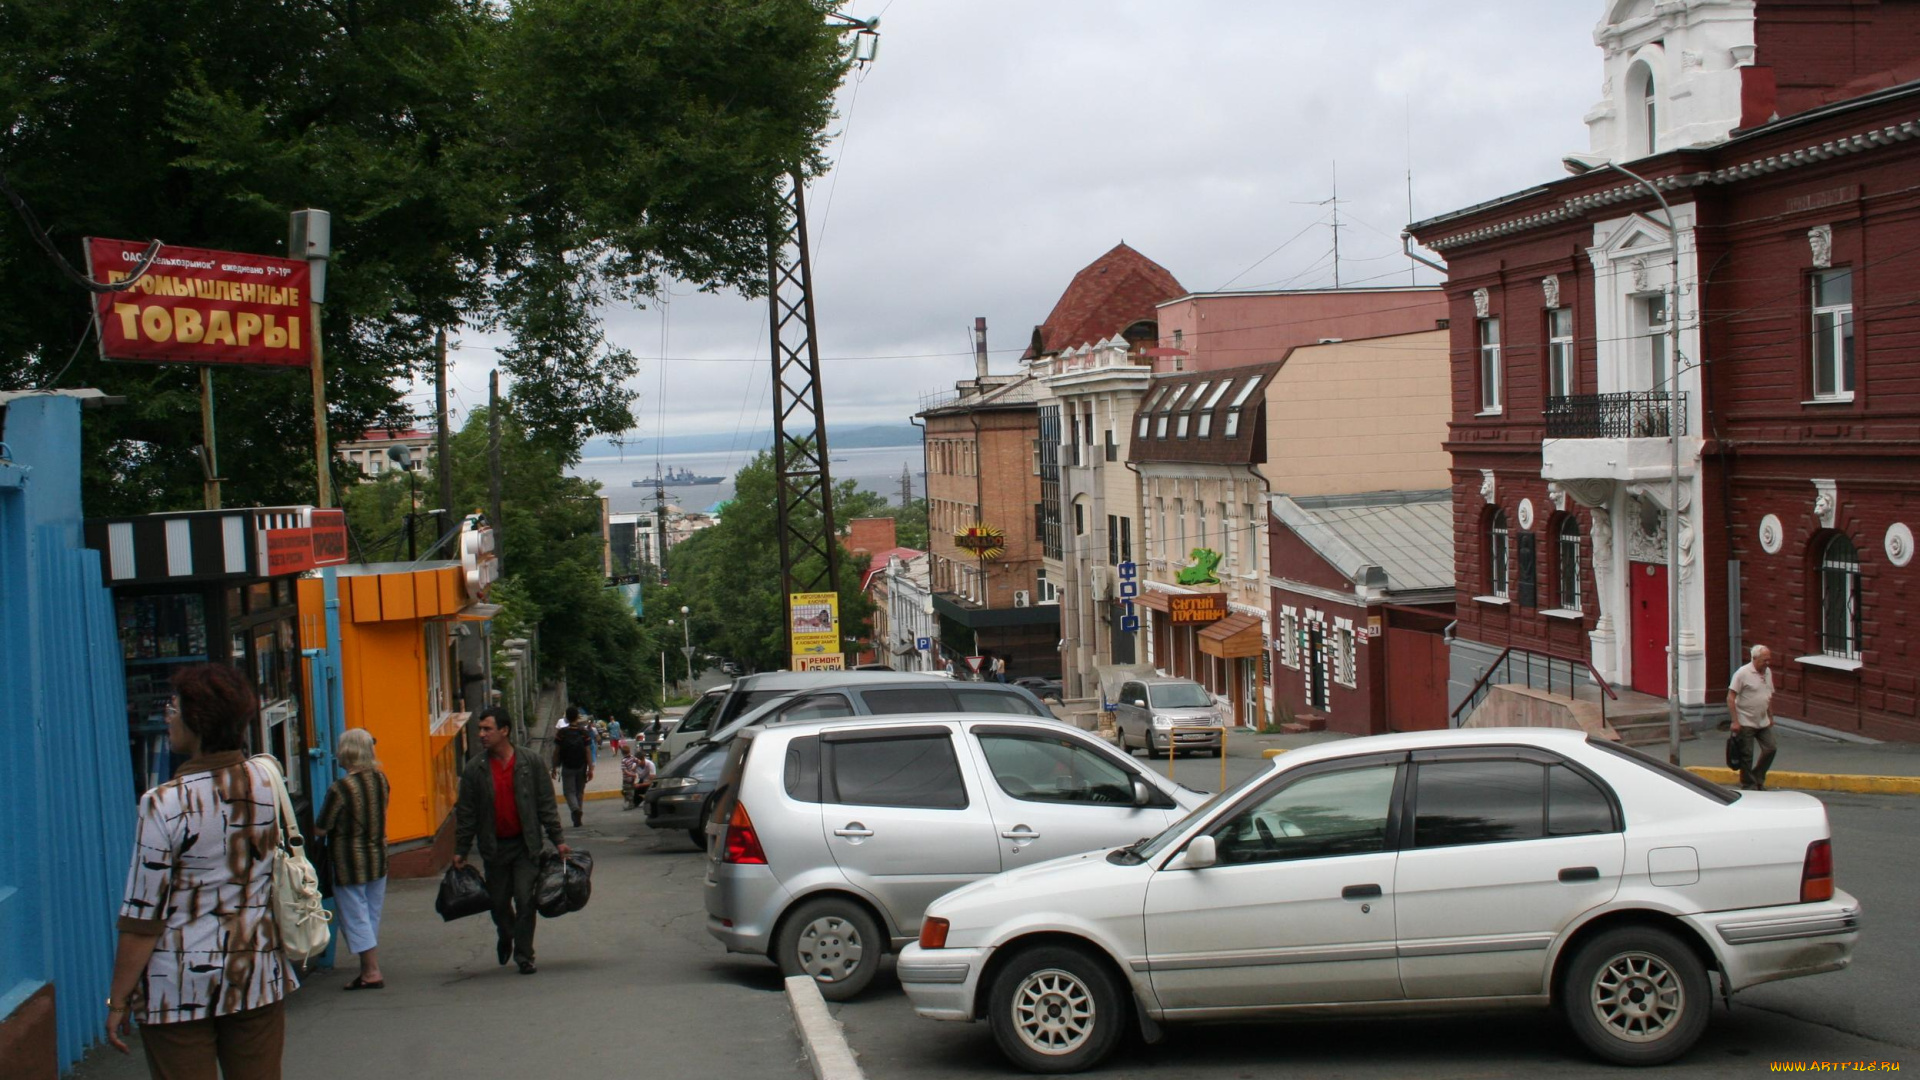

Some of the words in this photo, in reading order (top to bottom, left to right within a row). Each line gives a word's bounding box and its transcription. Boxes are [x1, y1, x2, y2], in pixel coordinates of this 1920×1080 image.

[114, 302, 300, 349] ТОВАРЫ
[1117, 561, 1139, 632] ФОТО
[1370, 626, 1379, 635] 21
